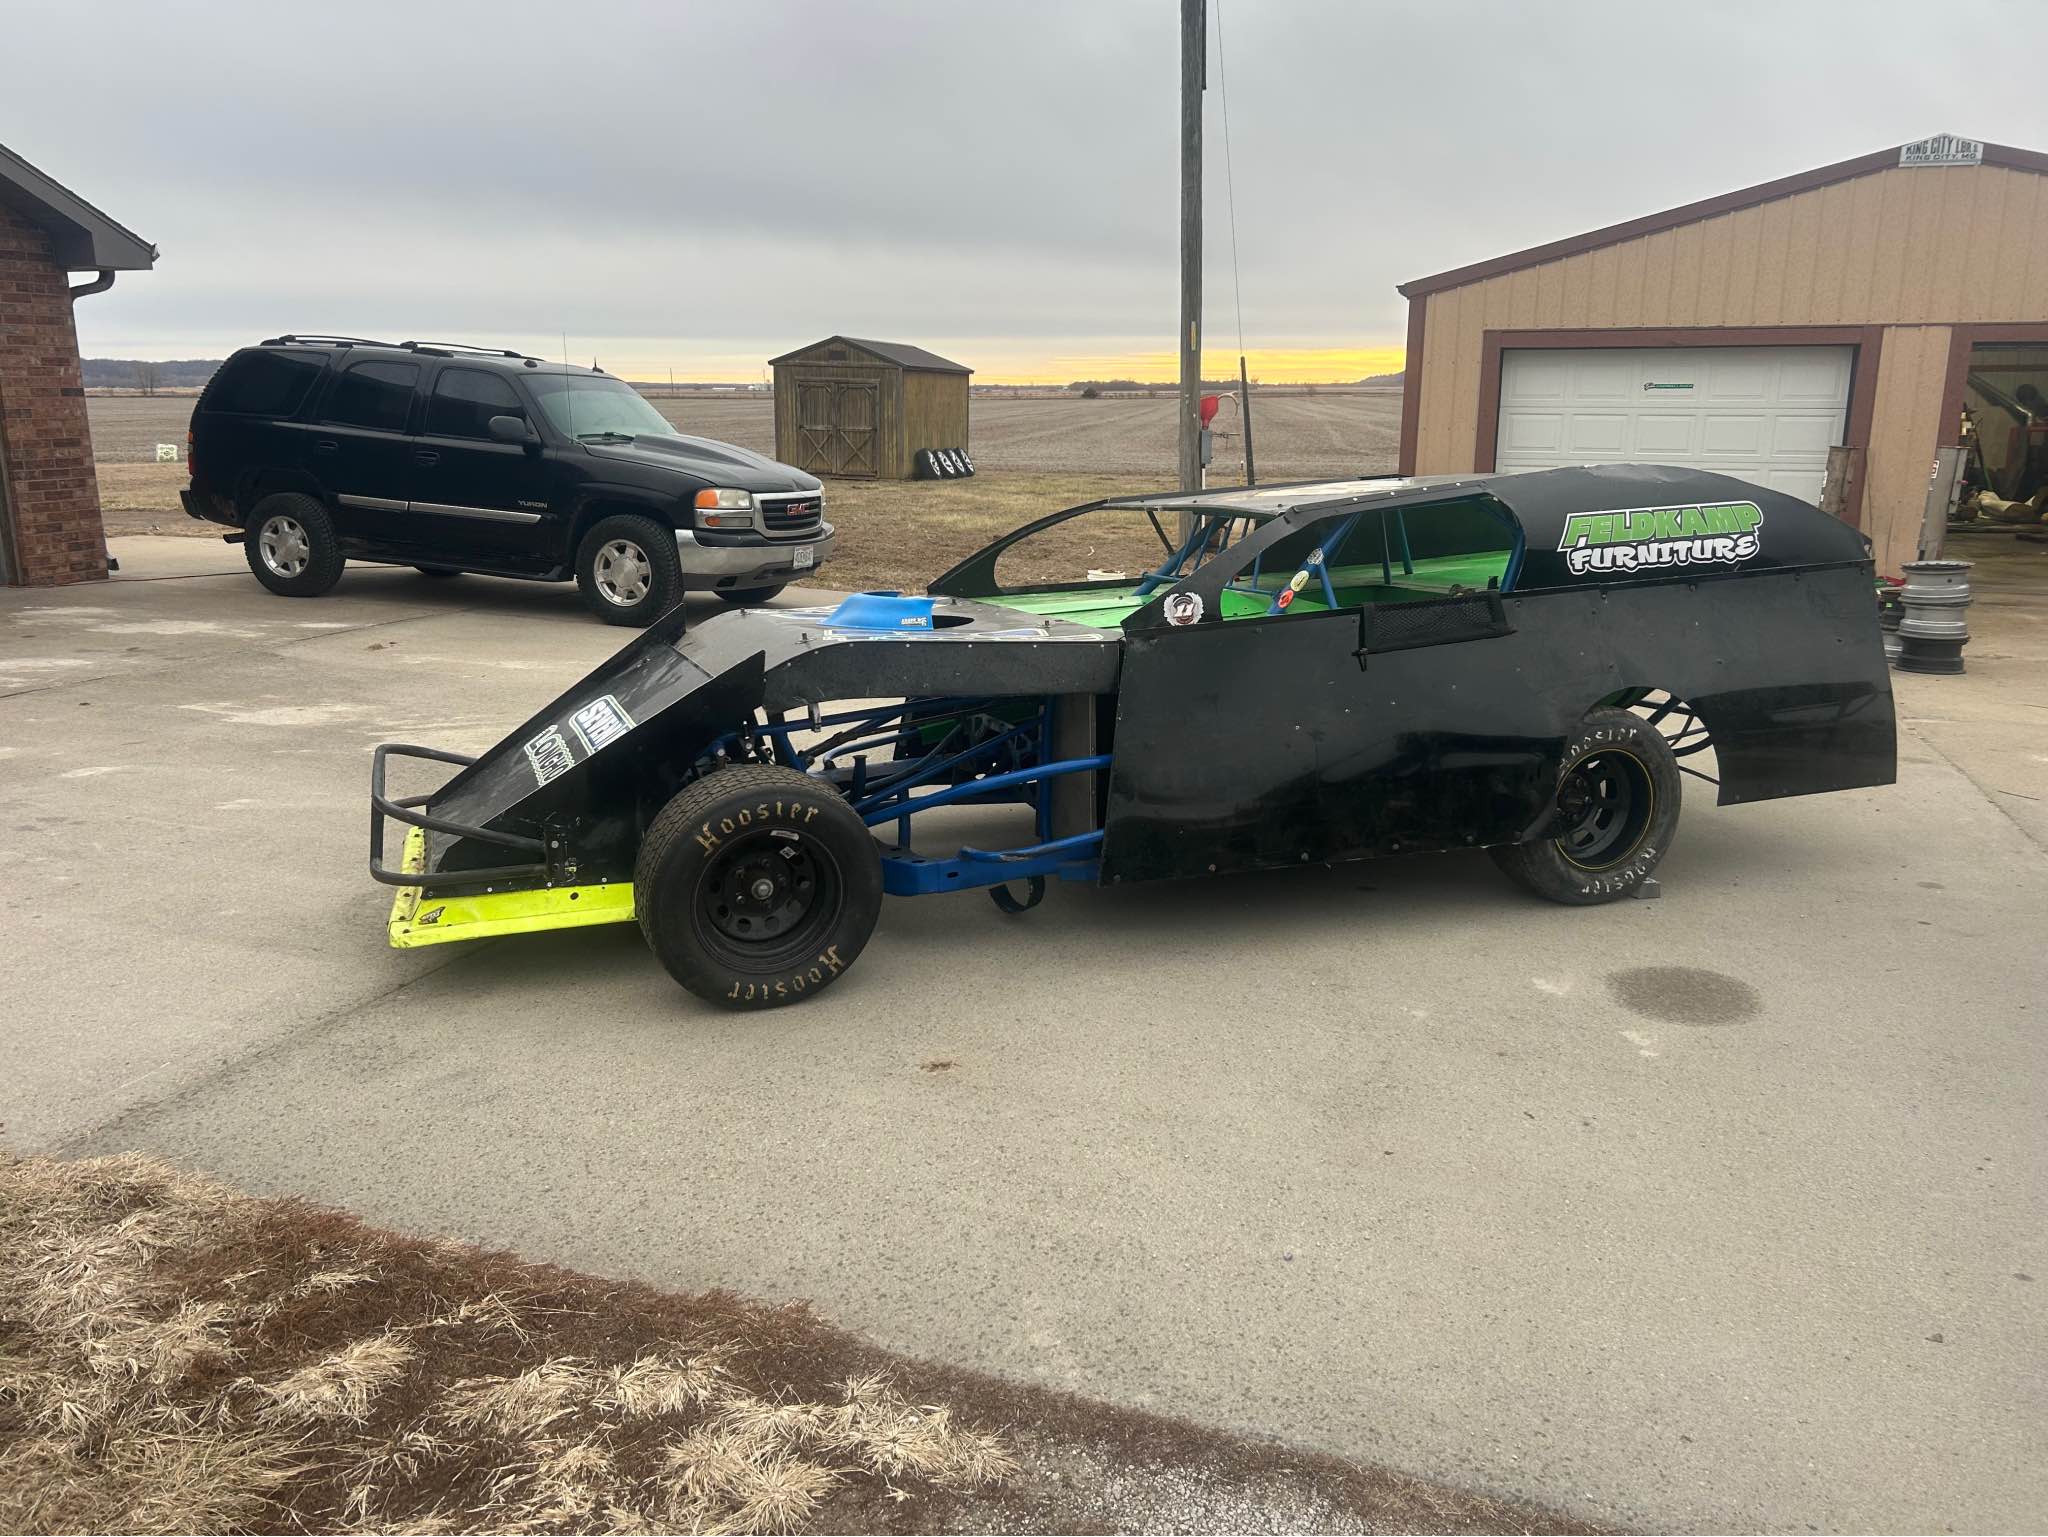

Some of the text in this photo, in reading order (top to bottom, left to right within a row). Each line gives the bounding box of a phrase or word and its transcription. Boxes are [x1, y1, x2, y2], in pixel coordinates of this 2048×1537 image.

[1905, 140, 1929, 155] KING
[1930, 135, 1954, 155] CITY
[787, 503, 810, 516] GMC
[1563, 502, 1763, 547] FELDKAMP
[1571, 535, 1757, 570] FURNITURE
[696, 801, 819, 857] Hoosier
